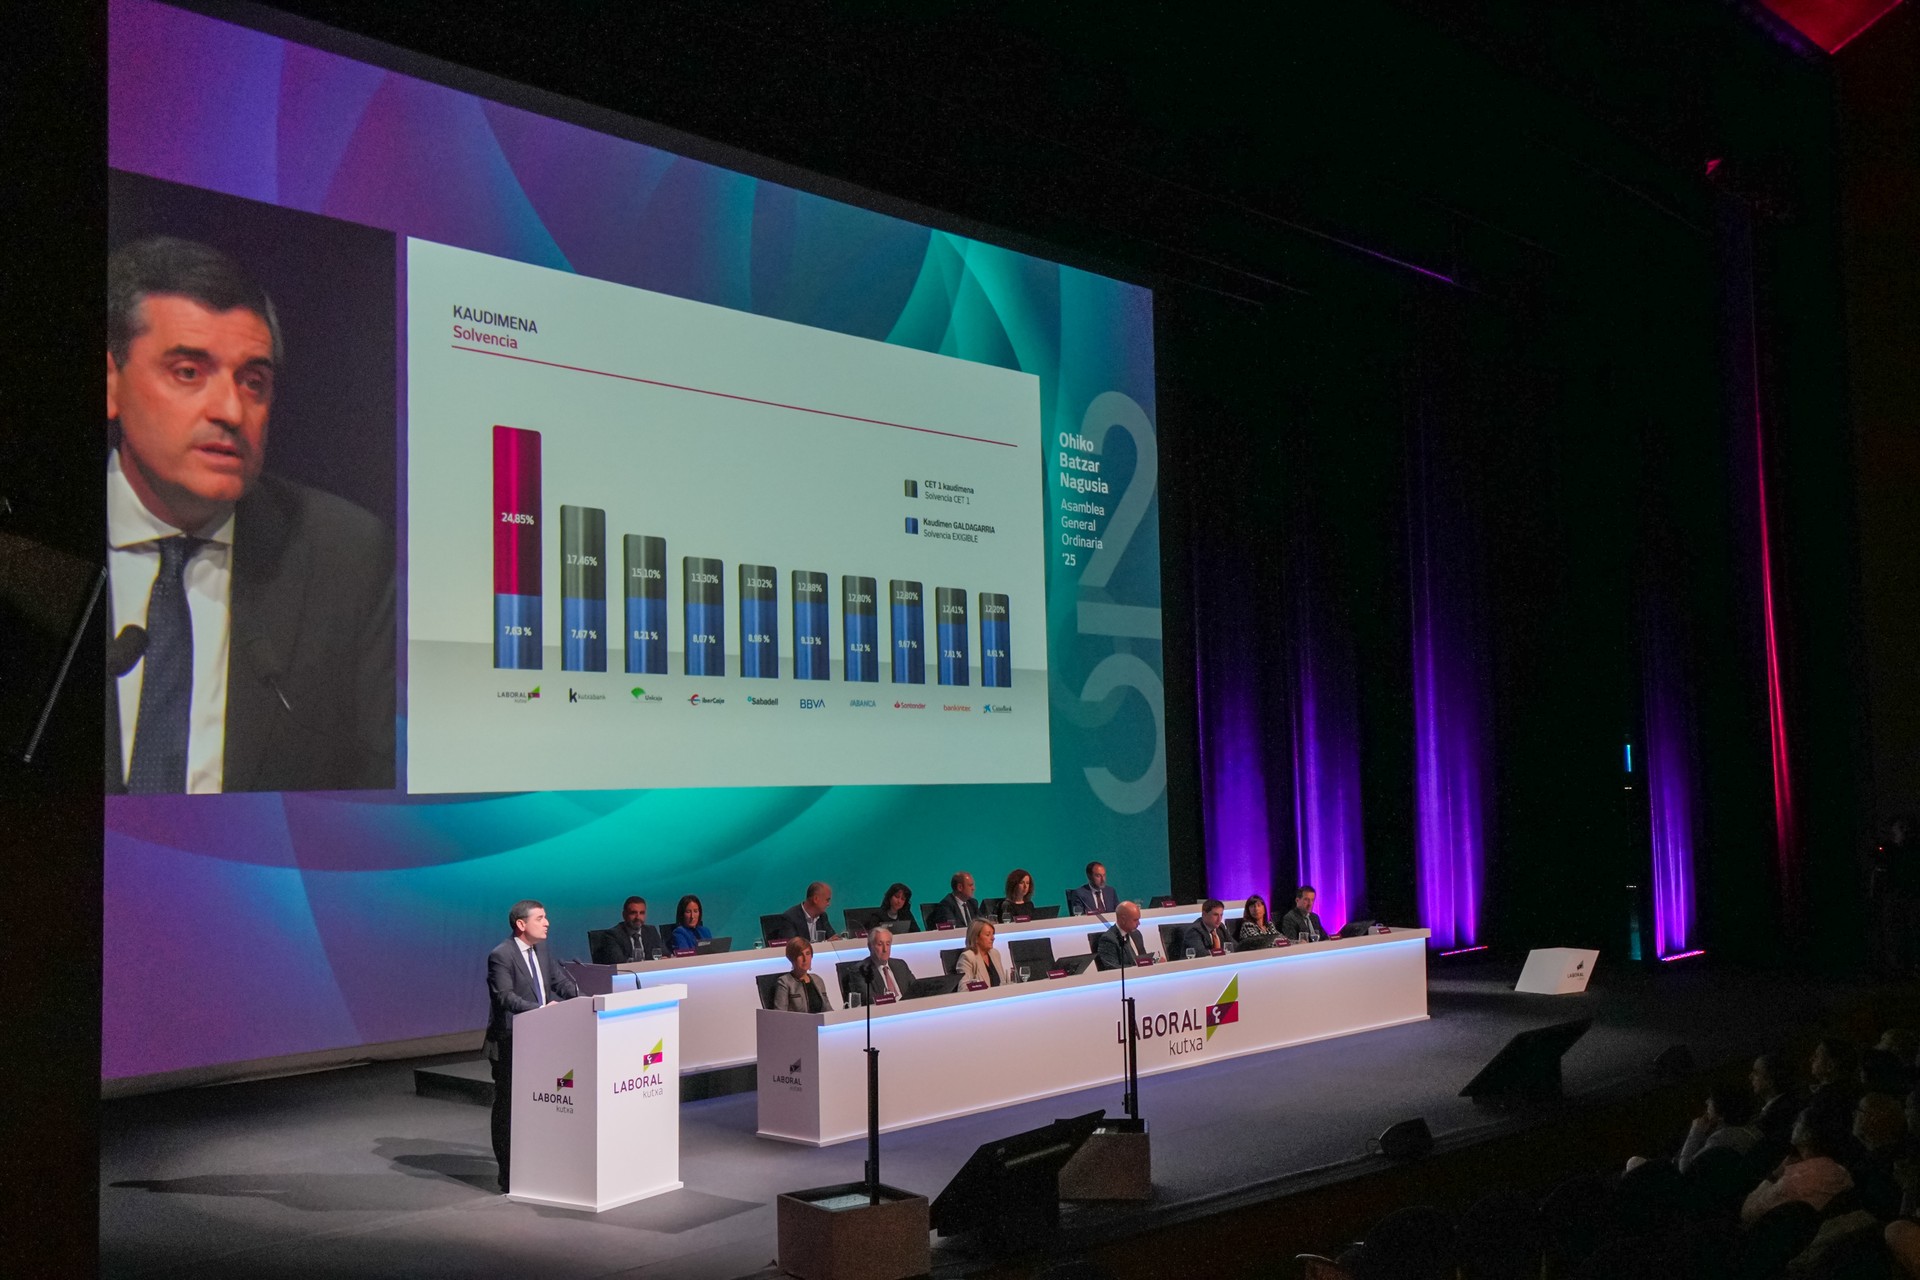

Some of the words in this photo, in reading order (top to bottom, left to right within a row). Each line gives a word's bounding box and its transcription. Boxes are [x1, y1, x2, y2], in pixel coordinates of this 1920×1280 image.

[453, 305, 538, 334] KAUDIMENA
[453, 325, 518, 349] Solvencia
[1059, 432, 1094, 452] Ohiko
[1060, 452, 1100, 473] Batzar
[924, 480, 936, 489] CET
[938, 481, 942, 490] 1
[943, 483, 975, 494] kaudimena
[1060, 472, 1109, 494] Nagusia
[924, 491, 953, 502] Solvencia
[953, 495, 965, 504] CET
[1061, 498, 1105, 516] Asamblea
[501, 512, 535, 525] 24,85%
[1061, 516, 1096, 531] General
[923, 518, 952, 528] Kaudimen
[953, 521, 996, 534] GALDAGARRIA
[923, 529, 951, 540] Solvencia
[952, 532, 978, 543] EXIGIBLE
[1062, 533, 1104, 550] Ordinaria
[567, 554, 598, 567] 17,46%
[1062, 553, 1076, 566] '25
[632, 568, 661, 579] 15,10%
[691, 573, 719, 584] 13,30%
[751, 697, 779, 706] Sabadell
[799, 698, 826, 709] BBVA
[1169, 1036, 1203, 1056] kutxa
[614, 1073, 663, 1094] LABORAL
[772, 1074, 802, 1086] LABORAL
[532, 1091, 574, 1106] LABORAL
[643, 1088, 663, 1099] kutxa
[556, 1105, 574, 1114] kutxa
